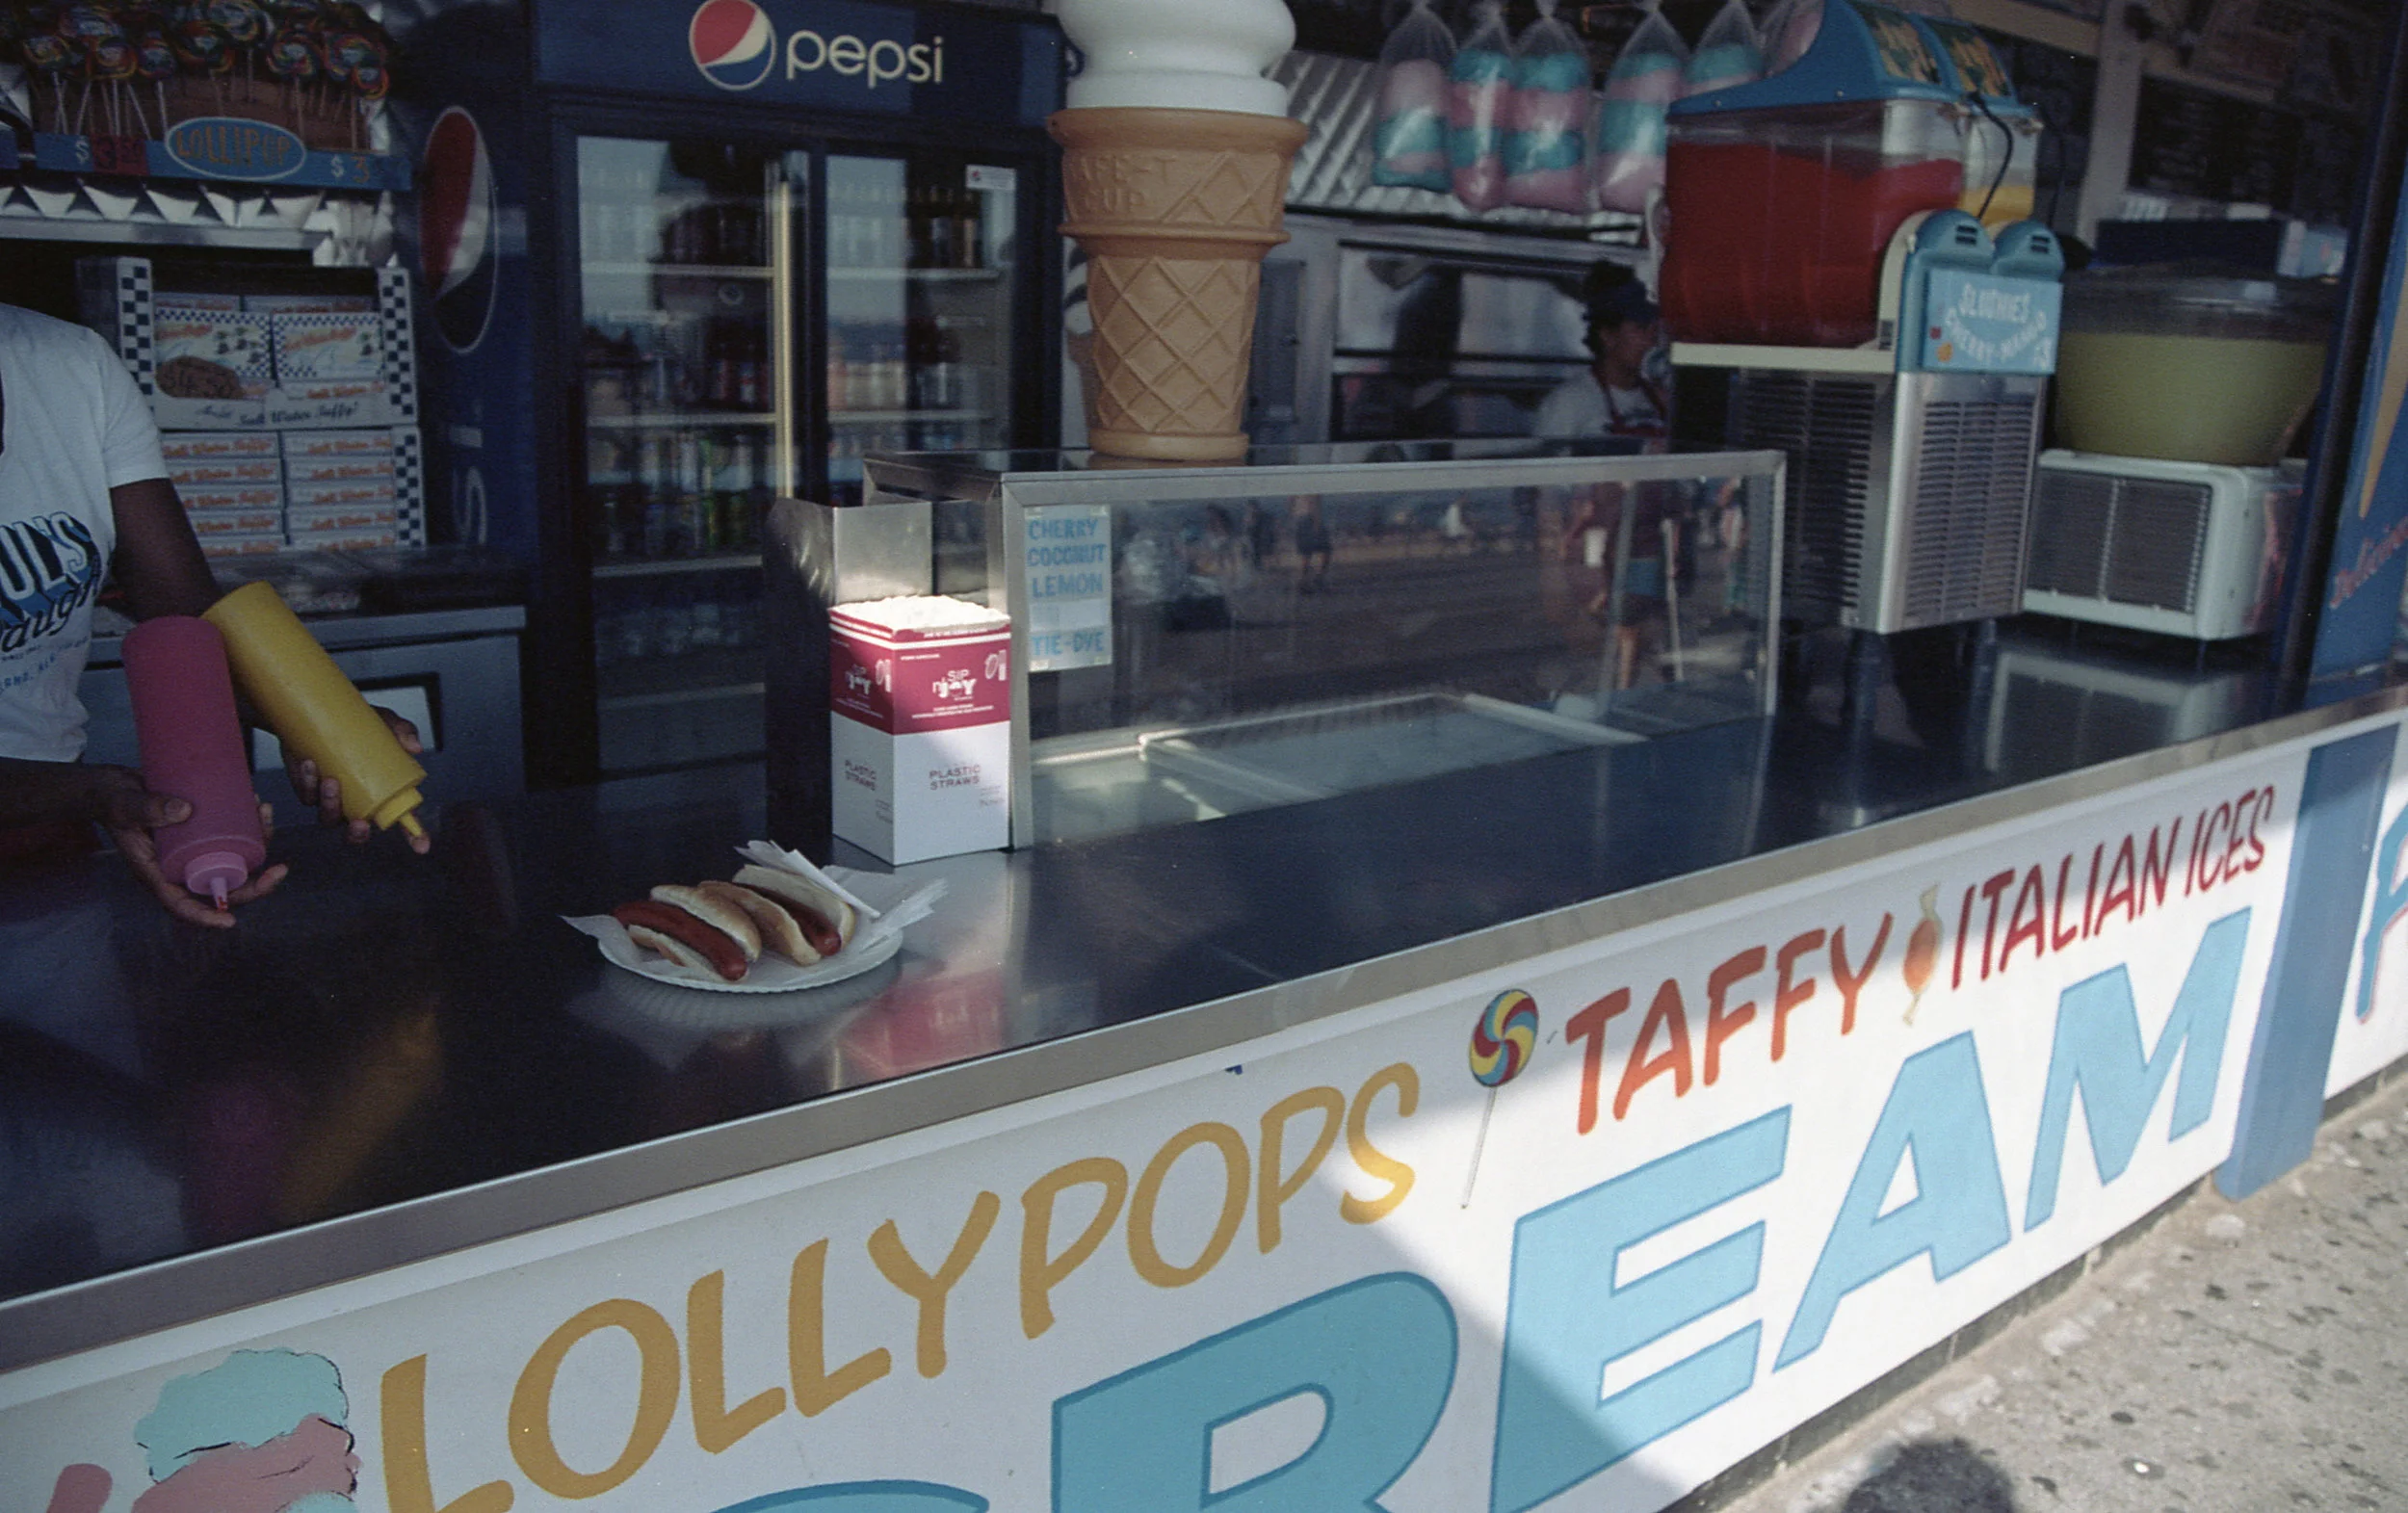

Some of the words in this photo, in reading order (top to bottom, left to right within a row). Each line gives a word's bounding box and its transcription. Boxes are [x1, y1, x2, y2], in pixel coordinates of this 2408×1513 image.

[785, 28, 945, 89] pepsi
[174, 125, 290, 168] LOLLIPOP
[1029, 518, 1099, 540] CHERRY
[1027, 543, 1107, 567] COCONUT
[1032, 573, 1104, 598] LEMON
[1032, 631, 1105, 656] TIE-DYE
[929, 764, 981, 779] PLASTIC
[929, 775, 980, 792] STRAWS
[1951, 818, 2182, 989] ITALIAN
[2184, 785, 2276, 898] ICES
[1564, 912, 1894, 1135] TAFFY
[708, 905, 2253, 1513] REAM
[380, 1062, 1421, 1513] LOLLYPOPS
